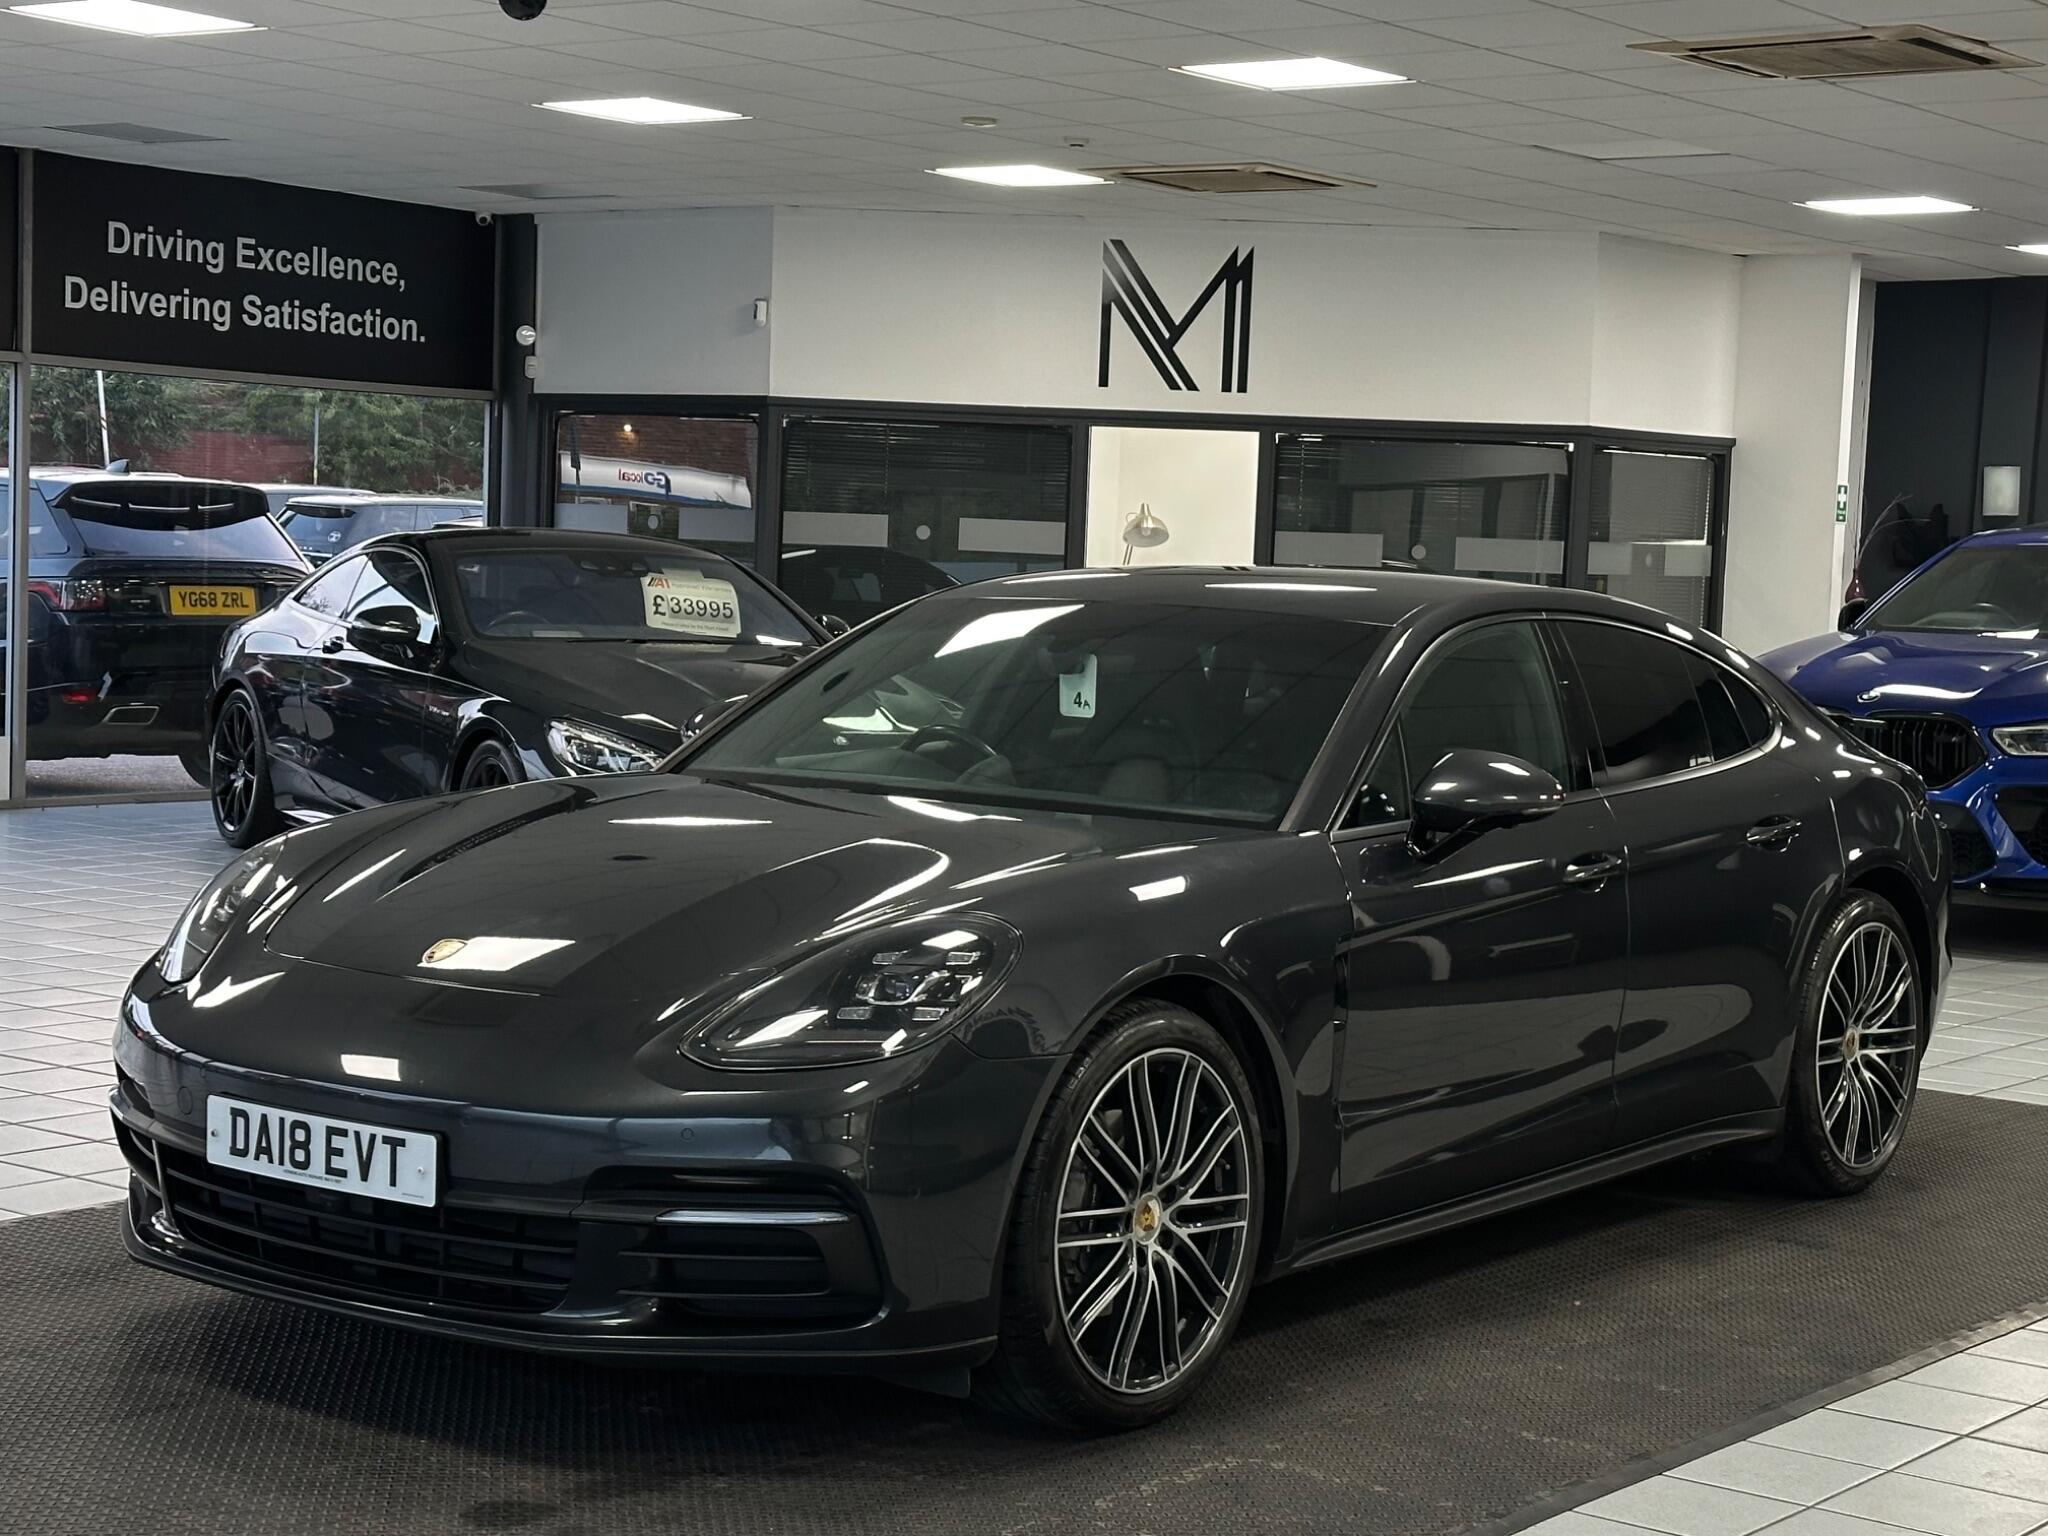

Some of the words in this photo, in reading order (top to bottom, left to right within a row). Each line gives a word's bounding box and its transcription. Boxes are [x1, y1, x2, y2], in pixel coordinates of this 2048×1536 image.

[107, 221, 225, 274] Driving
[236, 236, 405, 291] Excellence,
[64, 275, 231, 331] Delivering
[242, 294, 425, 342] Satisfaction.
[178, 591, 217, 608] YG68
[221, 592, 249, 608] ZRL
[229, 1106, 311, 1171] DA18
[324, 1125, 406, 1187] EVT
